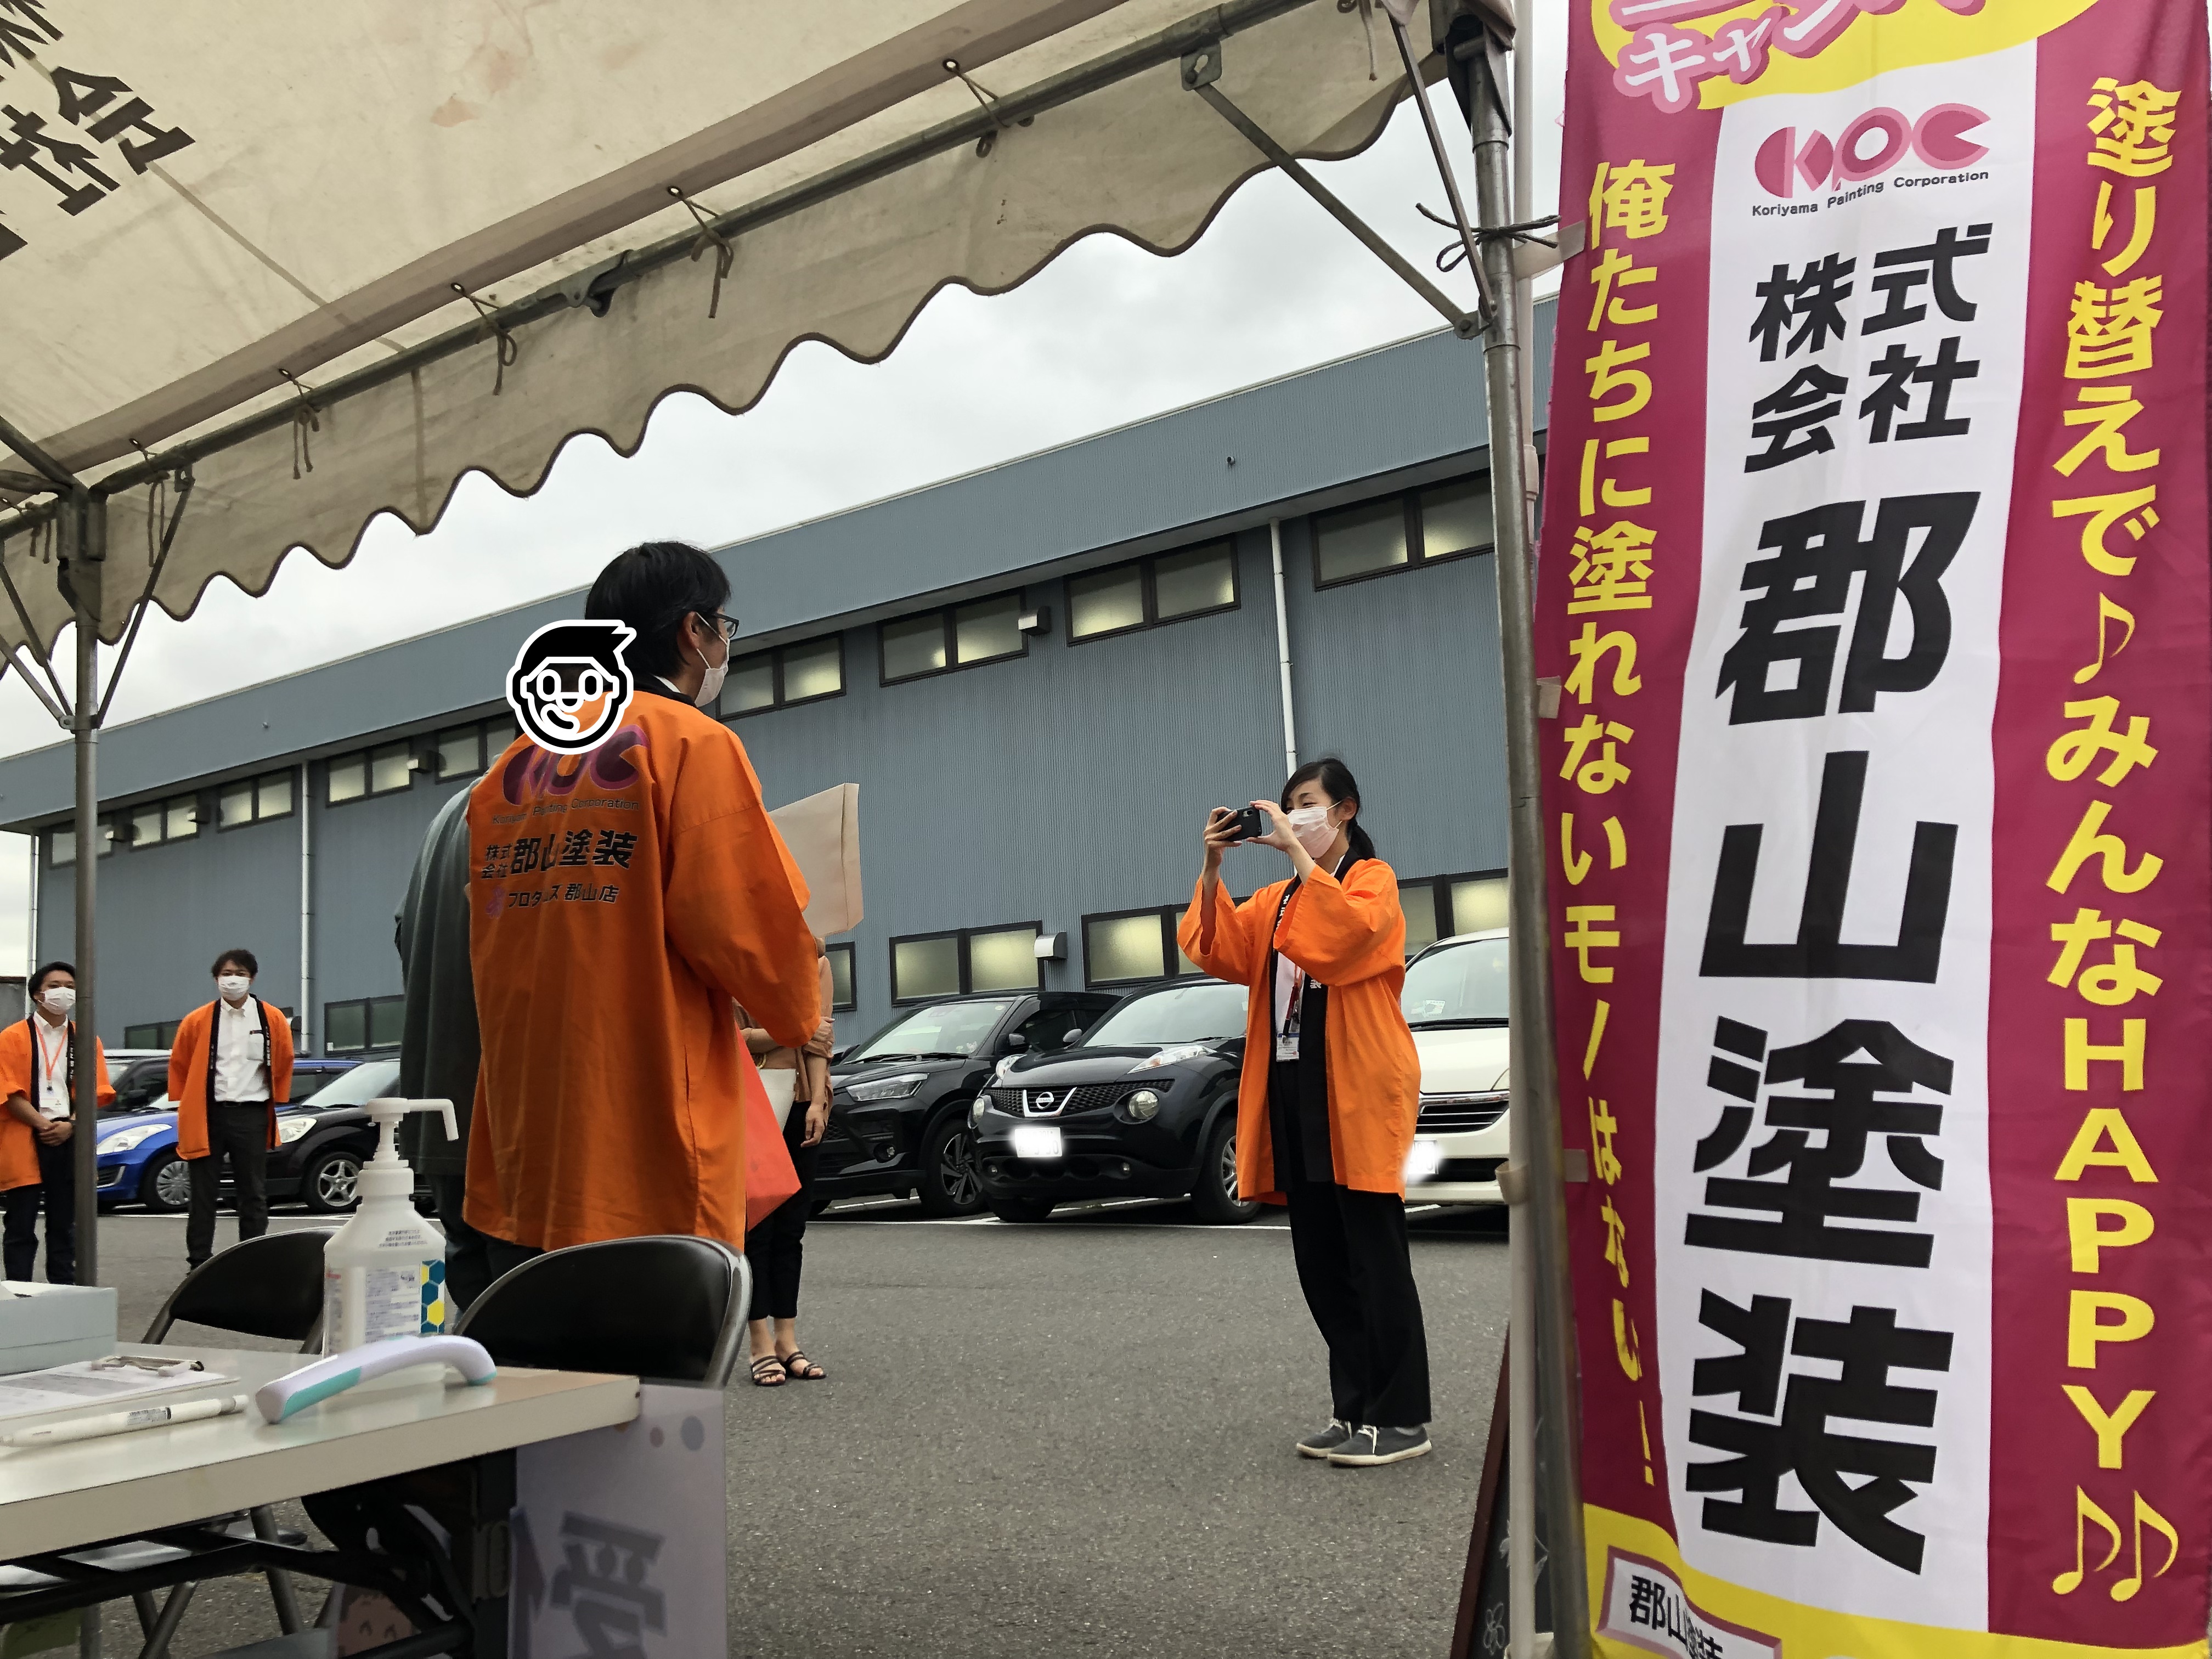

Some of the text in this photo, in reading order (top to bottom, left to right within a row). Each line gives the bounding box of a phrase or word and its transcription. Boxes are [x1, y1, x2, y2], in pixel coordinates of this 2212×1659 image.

[1752, 171, 1989, 217] Koriyama Painting Corporation
[571, 798, 640, 811] Corporation
[1684, 491, 1981, 1575] 郡山塗装
